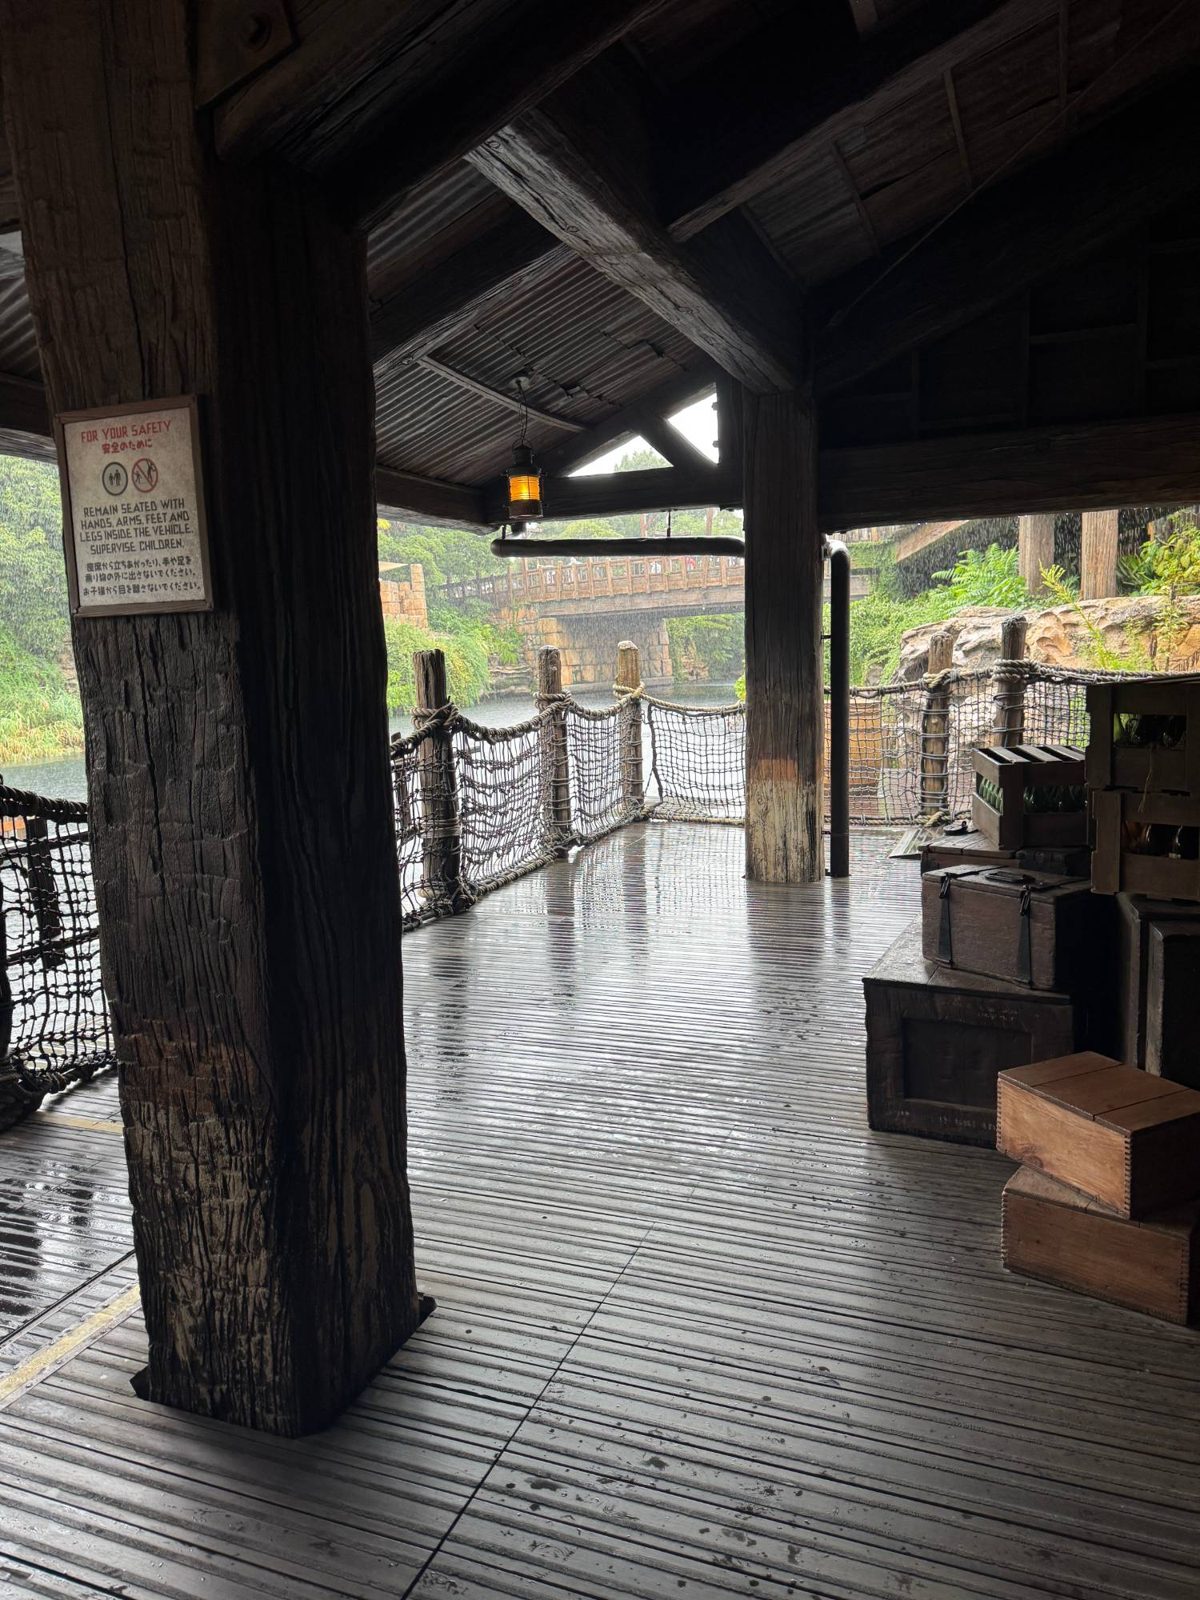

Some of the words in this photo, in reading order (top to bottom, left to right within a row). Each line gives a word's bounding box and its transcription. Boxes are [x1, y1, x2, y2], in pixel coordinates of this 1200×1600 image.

[81, 430, 98, 443] FOR
[102, 426, 128, 440] YOUR
[132, 420, 171, 436] SAFETY
[102, 440, 152, 454] 安全のために
[84, 505, 118, 518] REMAIN
[121, 501, 157, 514] SEATED
[161, 499, 184, 510] WITH
[146, 513, 167, 524] FEET
[170, 511, 189, 522] AND
[80, 531, 103, 543] LEGS
[105, 528, 132, 540] INSIDE
[134, 527, 151, 537] THE
[153, 523, 194, 536] VEHICLE.
[91, 542, 136, 555] SUPERVISE
